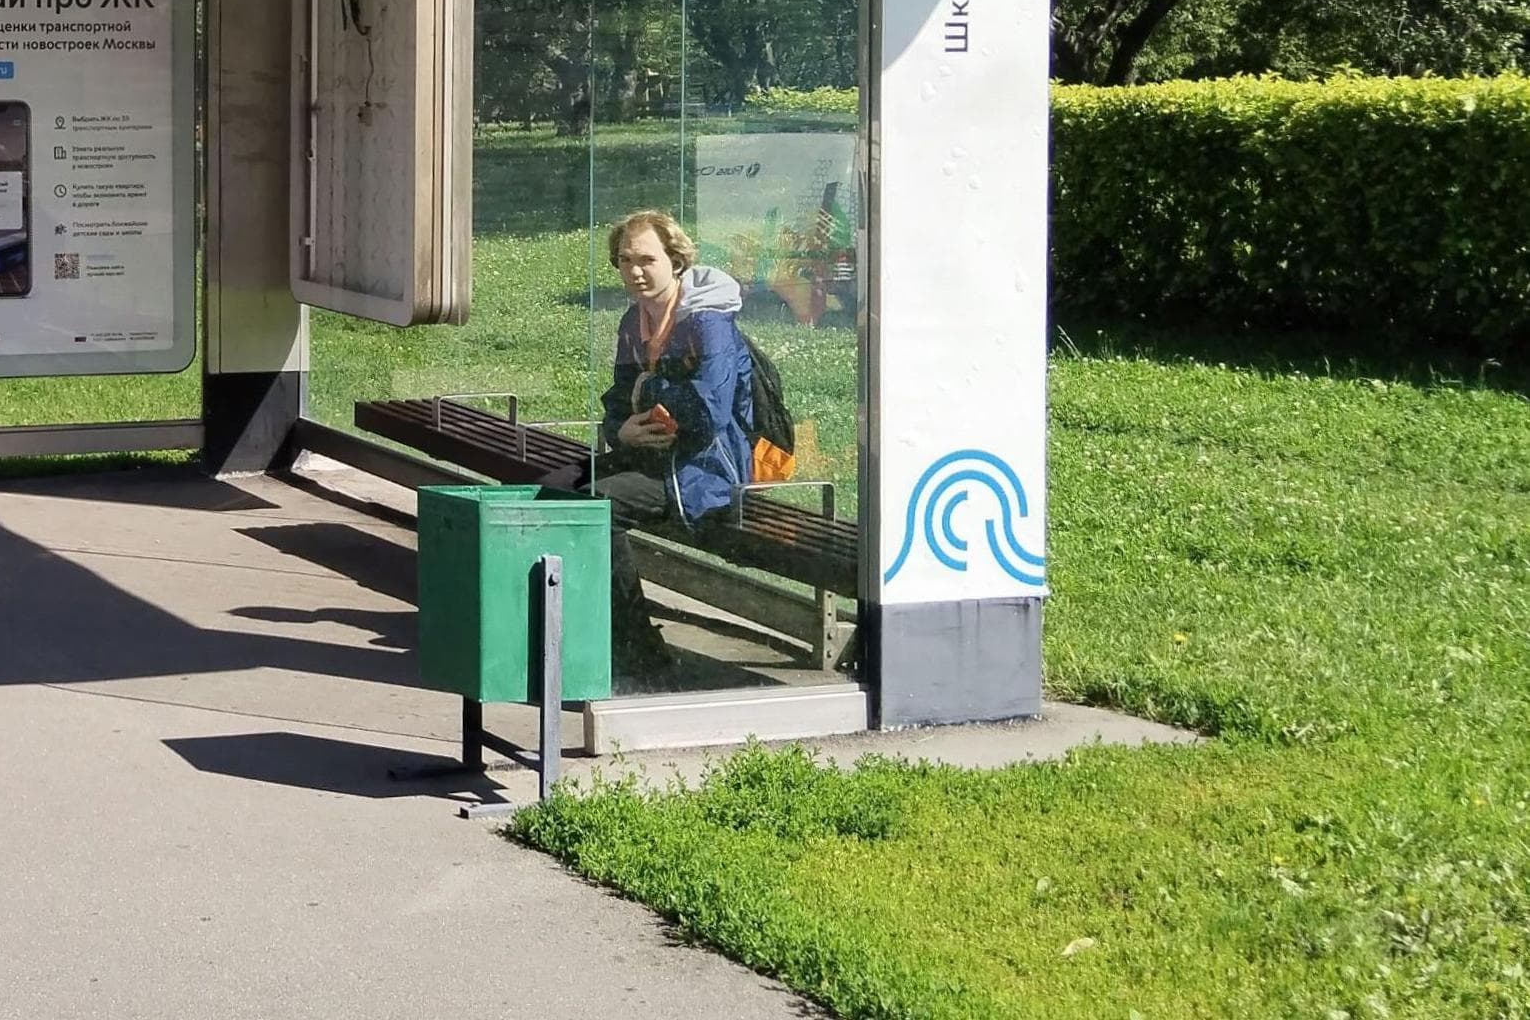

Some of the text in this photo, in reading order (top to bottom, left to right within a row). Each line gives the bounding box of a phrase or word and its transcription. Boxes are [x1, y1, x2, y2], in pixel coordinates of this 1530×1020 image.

[39, 20, 132, 35] транспортной
[22, 38, 100, 52] новостроек
[102, 37, 156, 50] Москвы
